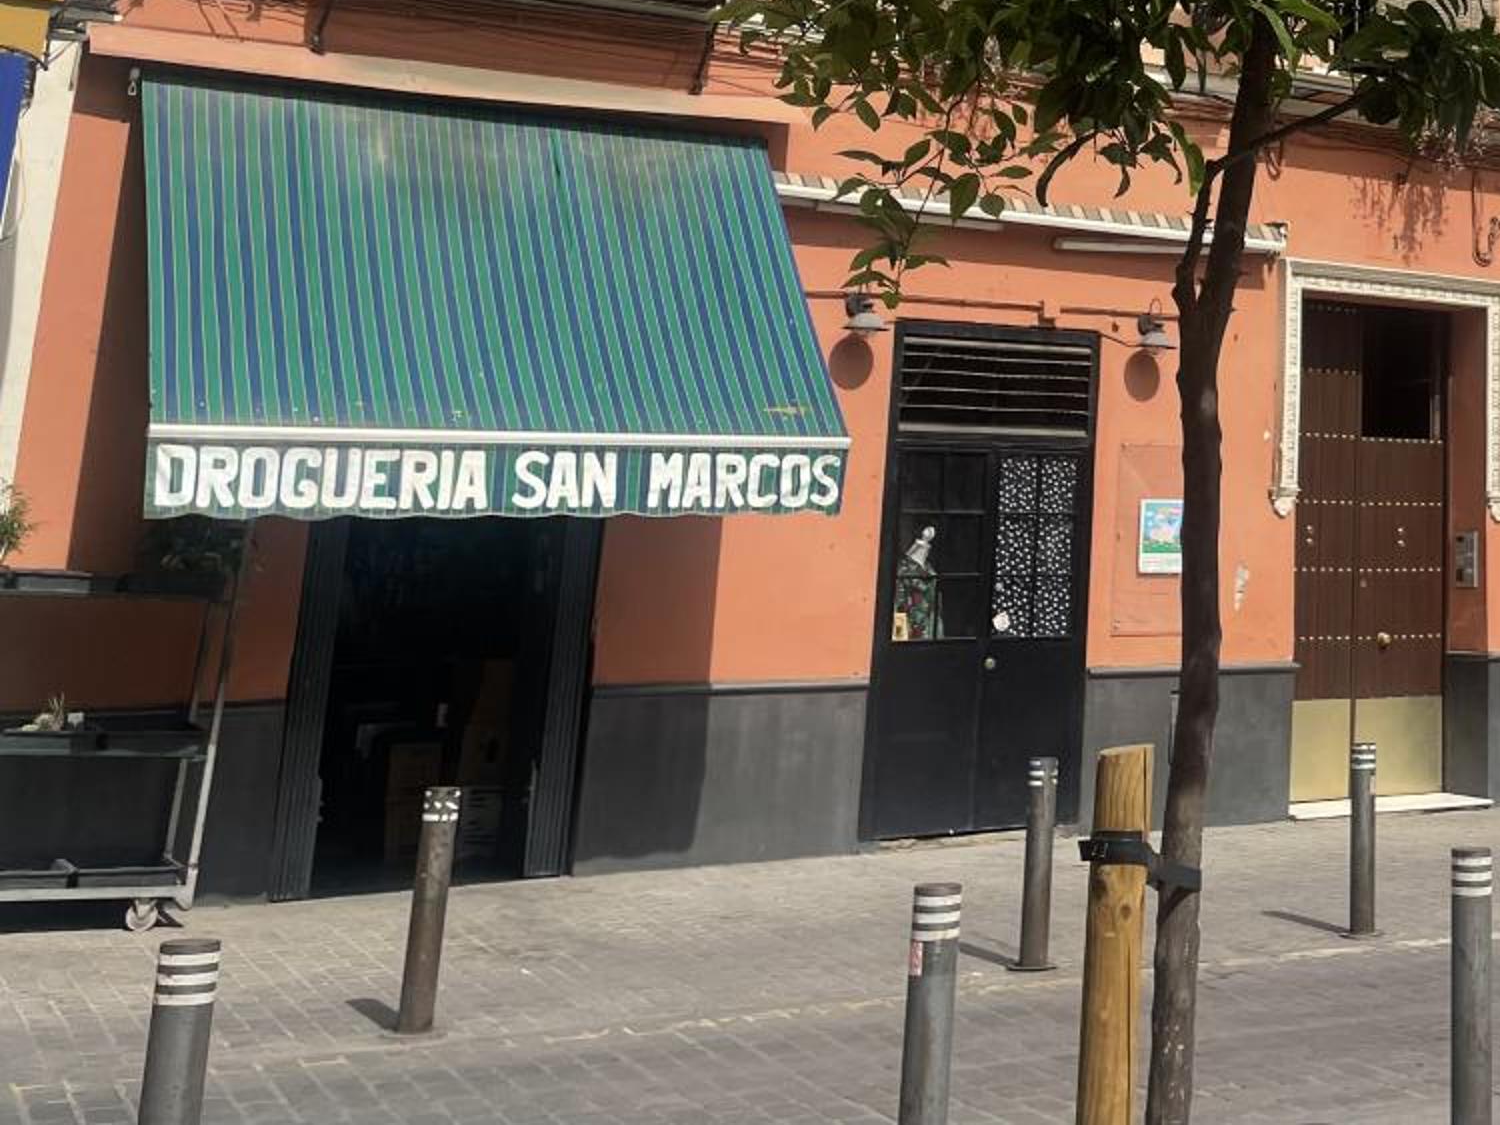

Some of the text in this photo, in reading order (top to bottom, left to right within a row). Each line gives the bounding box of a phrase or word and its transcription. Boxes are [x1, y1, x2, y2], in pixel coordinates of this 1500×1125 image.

[154, 443, 841, 510] DROGUERIA SAN MARCOS
